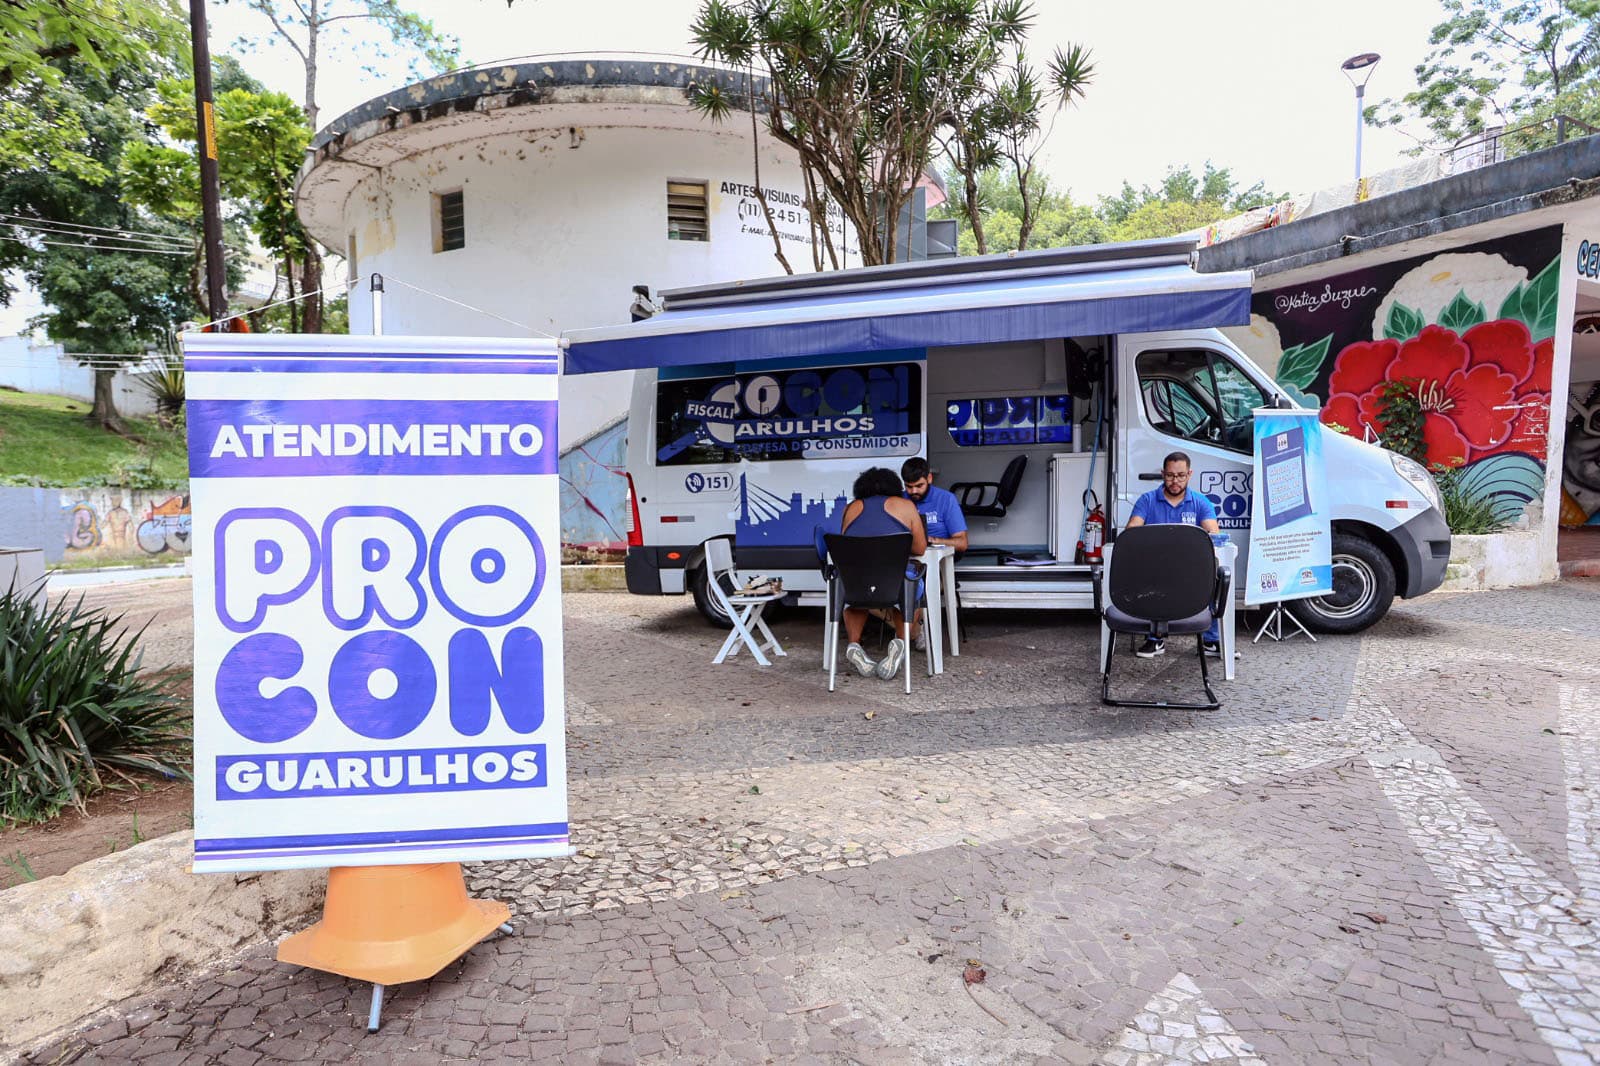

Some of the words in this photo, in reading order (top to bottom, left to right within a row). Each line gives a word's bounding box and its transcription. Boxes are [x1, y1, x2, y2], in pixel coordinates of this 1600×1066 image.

[720, 181, 757, 199] ARTES
[763, 188, 801, 206] VISUAIS
[1577, 239, 1600, 279] CE
[210, 423, 543, 458] ATENDIMENTO
[791, 439, 811, 452] DO
[815, 435, 909, 450] CONSUMIDOR
[706, 476, 729, 489] 151
[1200, 471, 1253, 494] PR
[214, 505, 546, 633] PRO
[215, 626, 543, 743] CON
[225, 751, 539, 793] GUARULHOS
